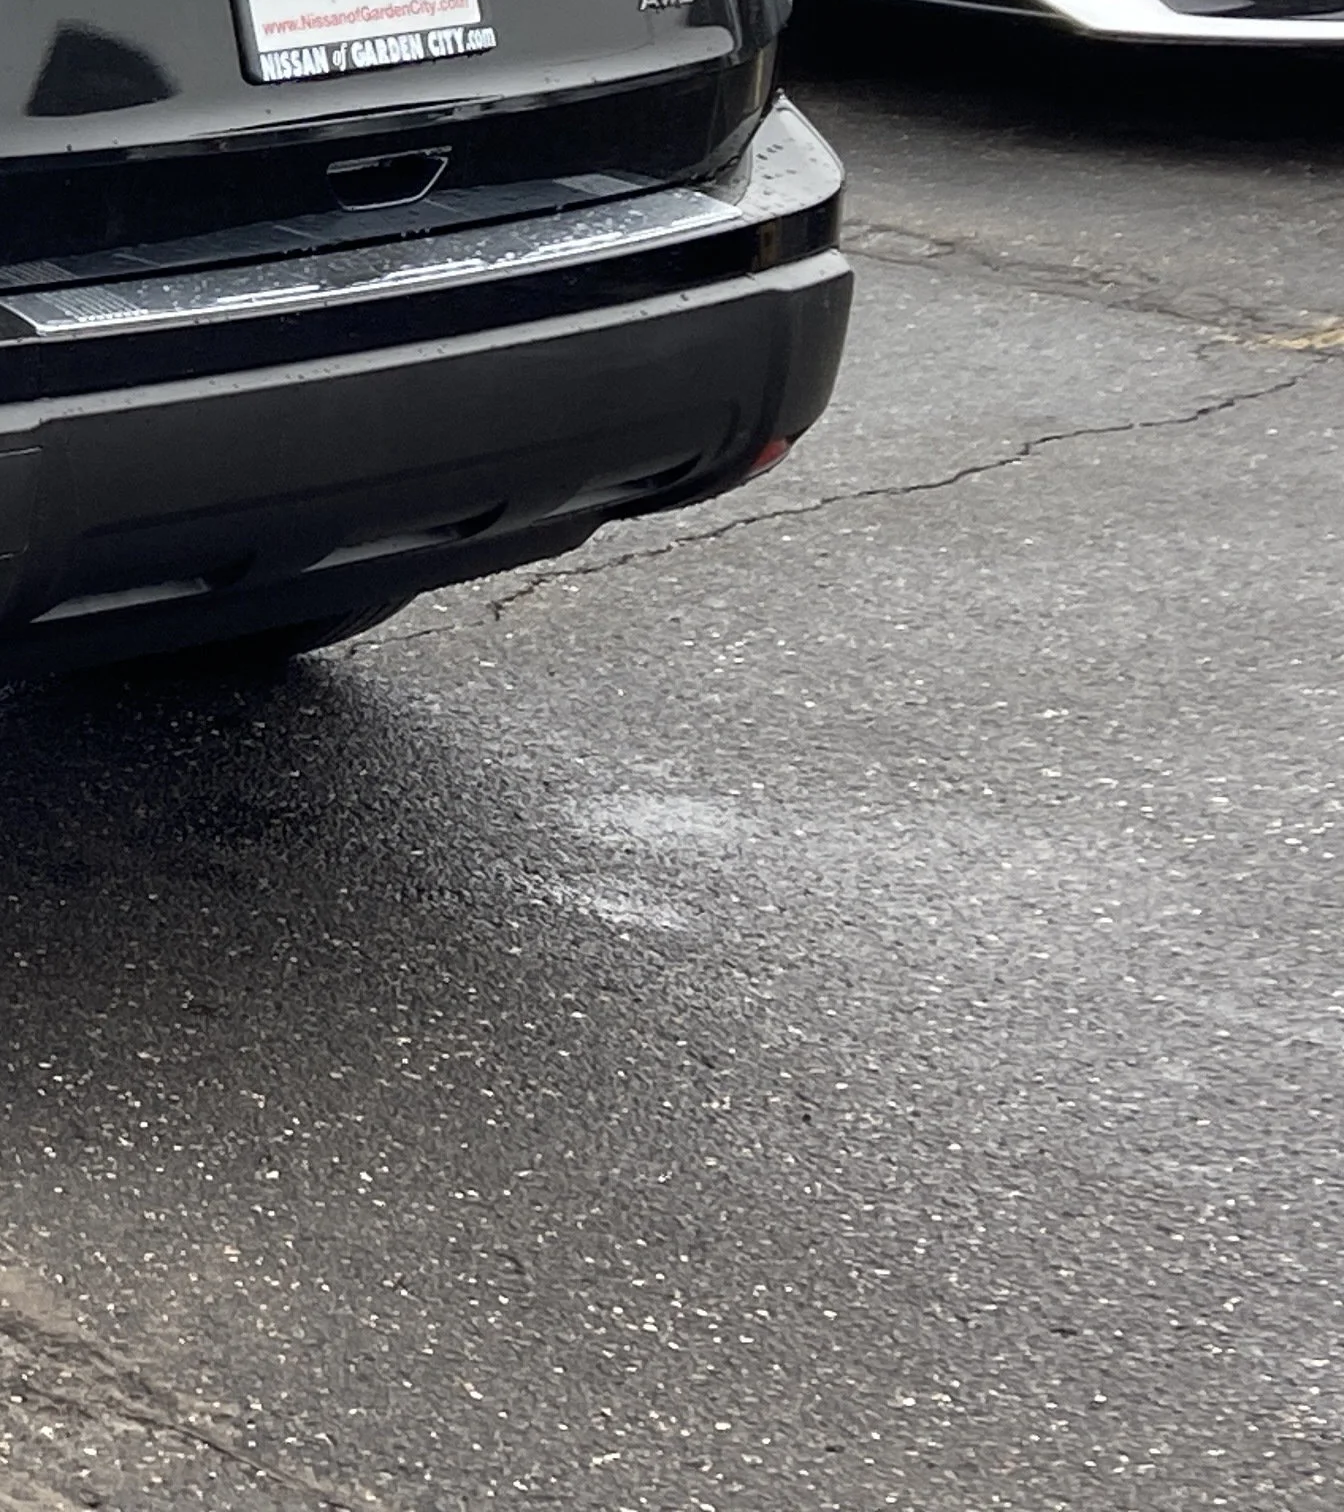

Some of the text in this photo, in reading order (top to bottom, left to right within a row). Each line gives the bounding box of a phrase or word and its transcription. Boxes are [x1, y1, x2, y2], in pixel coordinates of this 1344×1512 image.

[260, 27, 497, 82] NISSAN of GARDEN CITY.com
